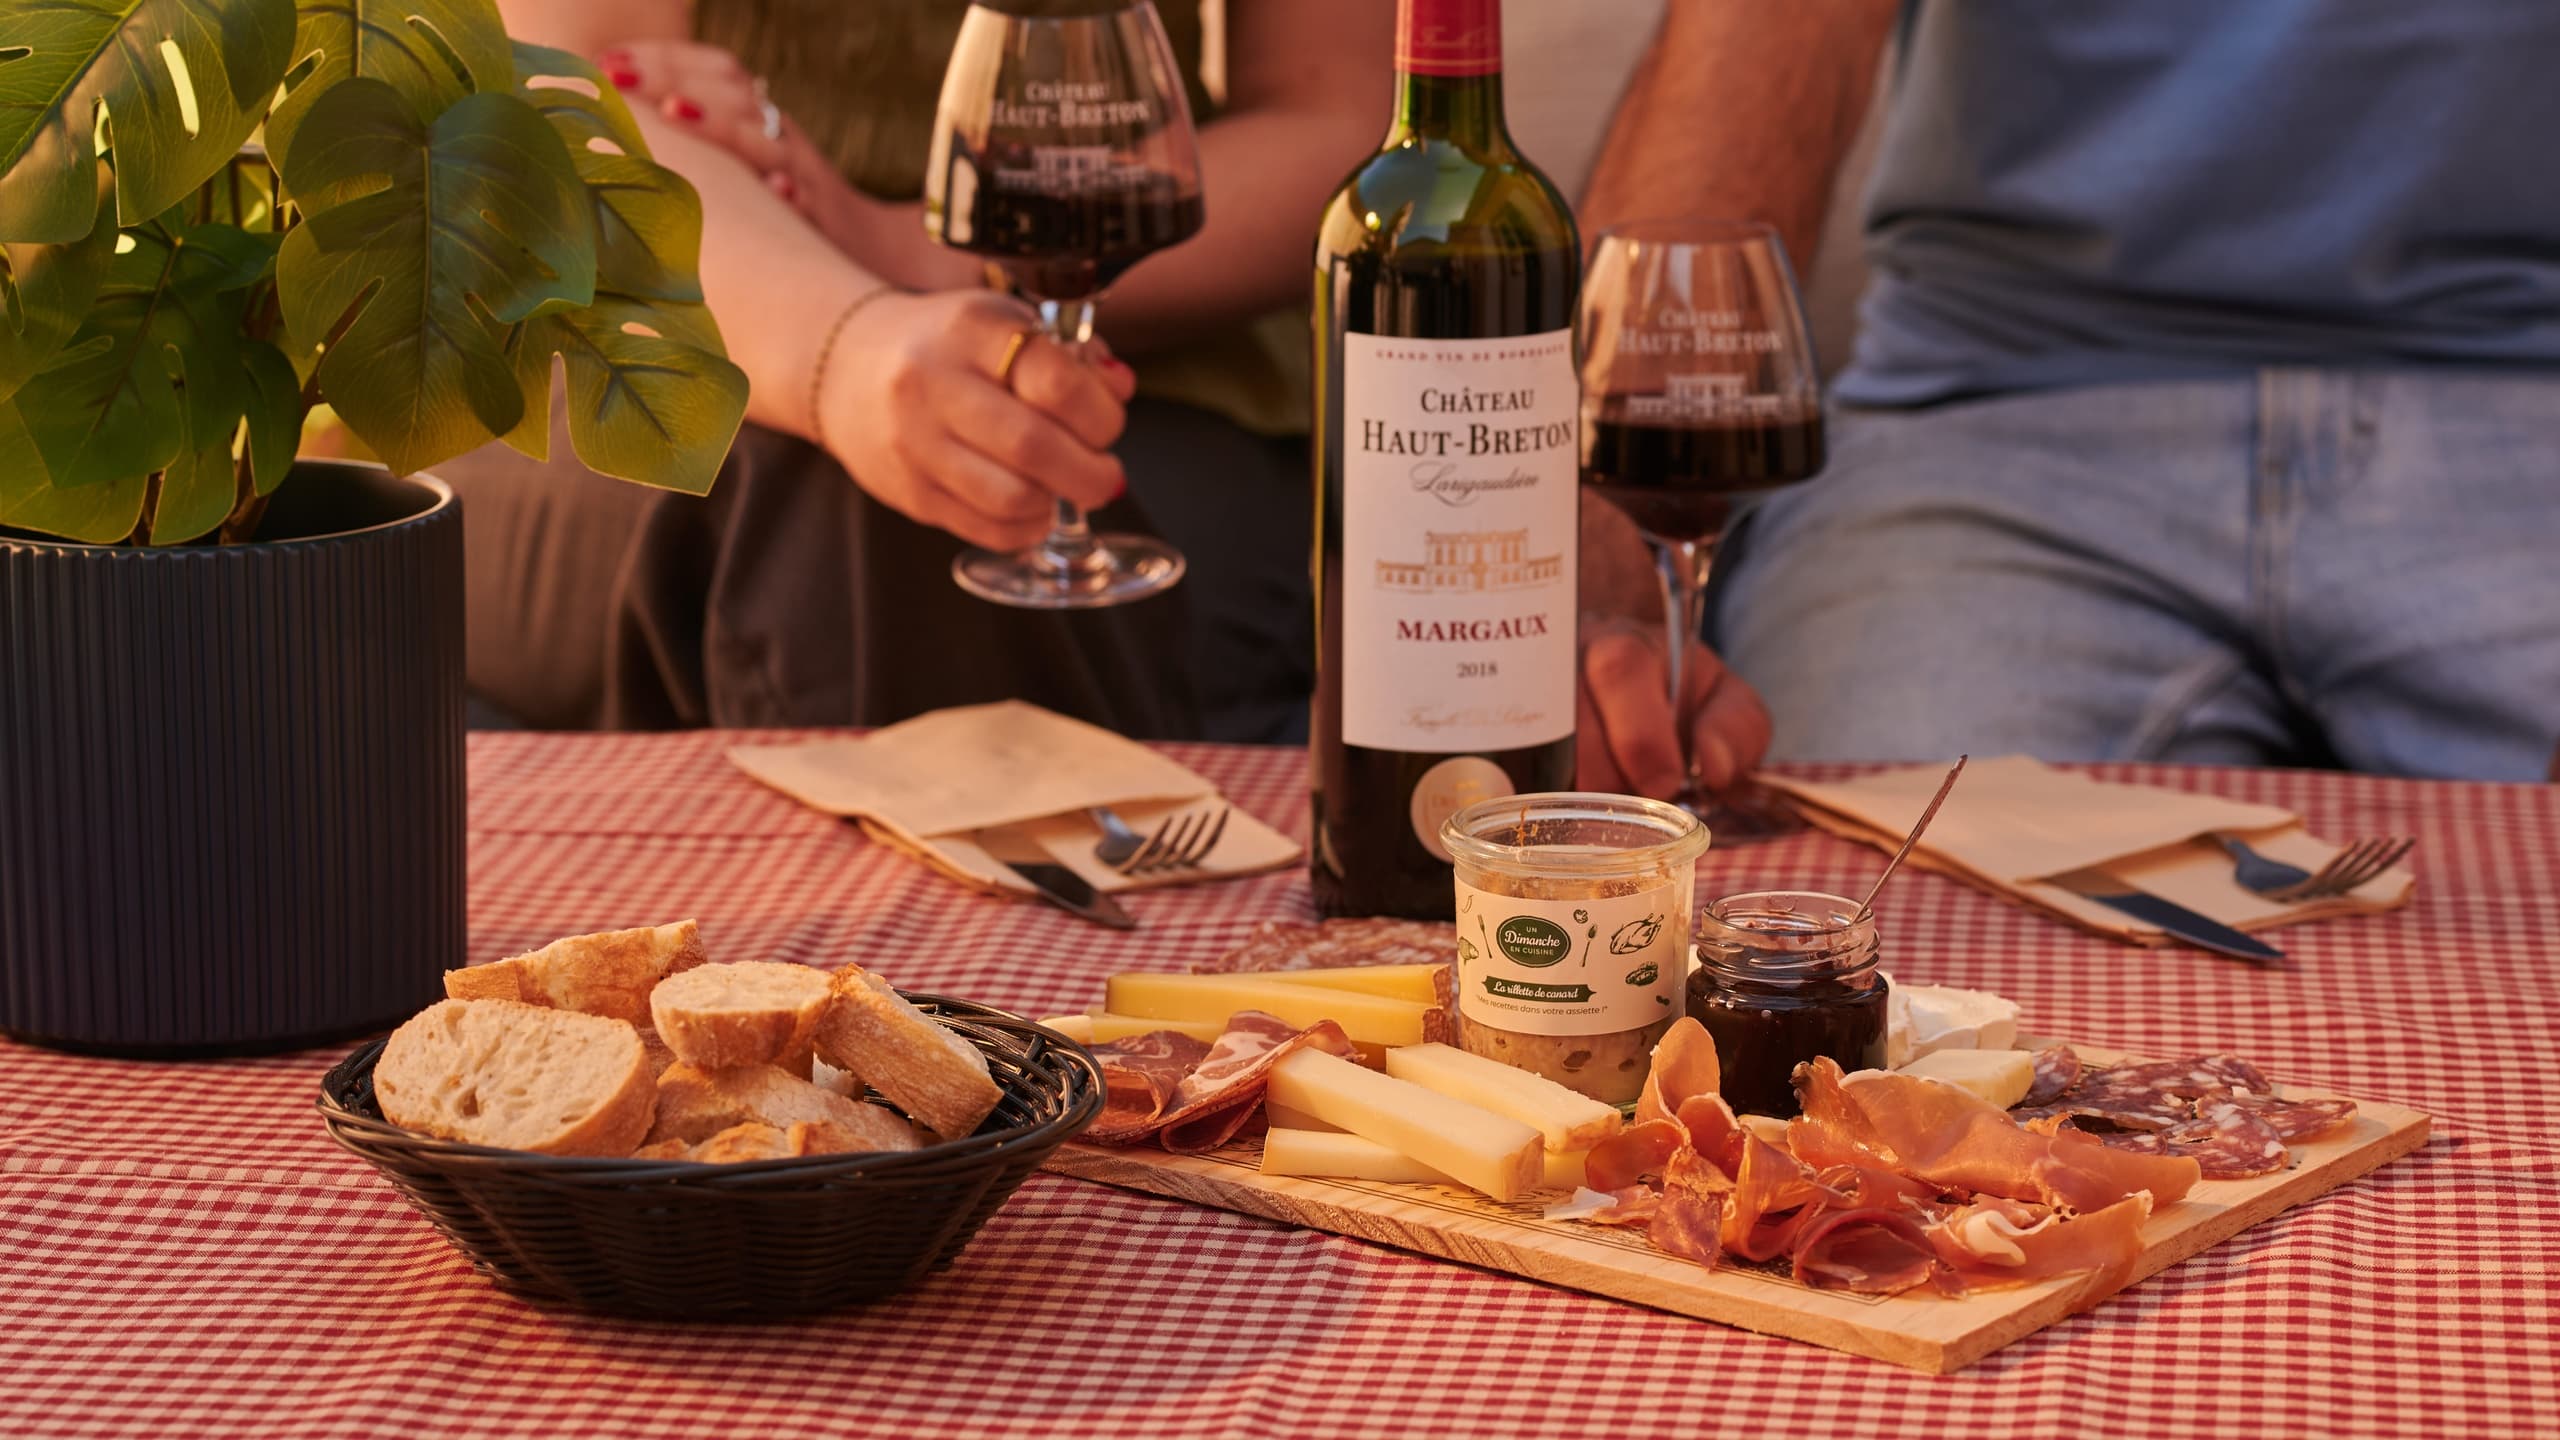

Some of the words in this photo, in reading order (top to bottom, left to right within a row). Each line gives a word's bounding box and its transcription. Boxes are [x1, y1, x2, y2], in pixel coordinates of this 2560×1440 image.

[1472, 351, 1490, 362] DE
[1420, 386, 1535, 414] CHÂTEAU
[1363, 418, 1573, 456] HAUT-BRETON
[1397, 613, 1548, 641] MARGAUX
[1457, 661, 1499, 679] 2018
[1504, 929, 1561, 948] Dimanche
[1510, 945, 1521, 953] EN
[1522, 947, 1555, 956] CUISINE
[1493, 981, 1506, 993] La
[1507, 984, 1534, 997] rillette
[1534, 987, 1546, 998] de
[1546, 988, 1579, 999] canard
[1490, 1000, 1519, 1011] recettes
[1520, 1004, 1541, 1014] dans
[1542, 1008, 1565, 1016] votre
[1565, 1007, 1600, 1016] assiette
